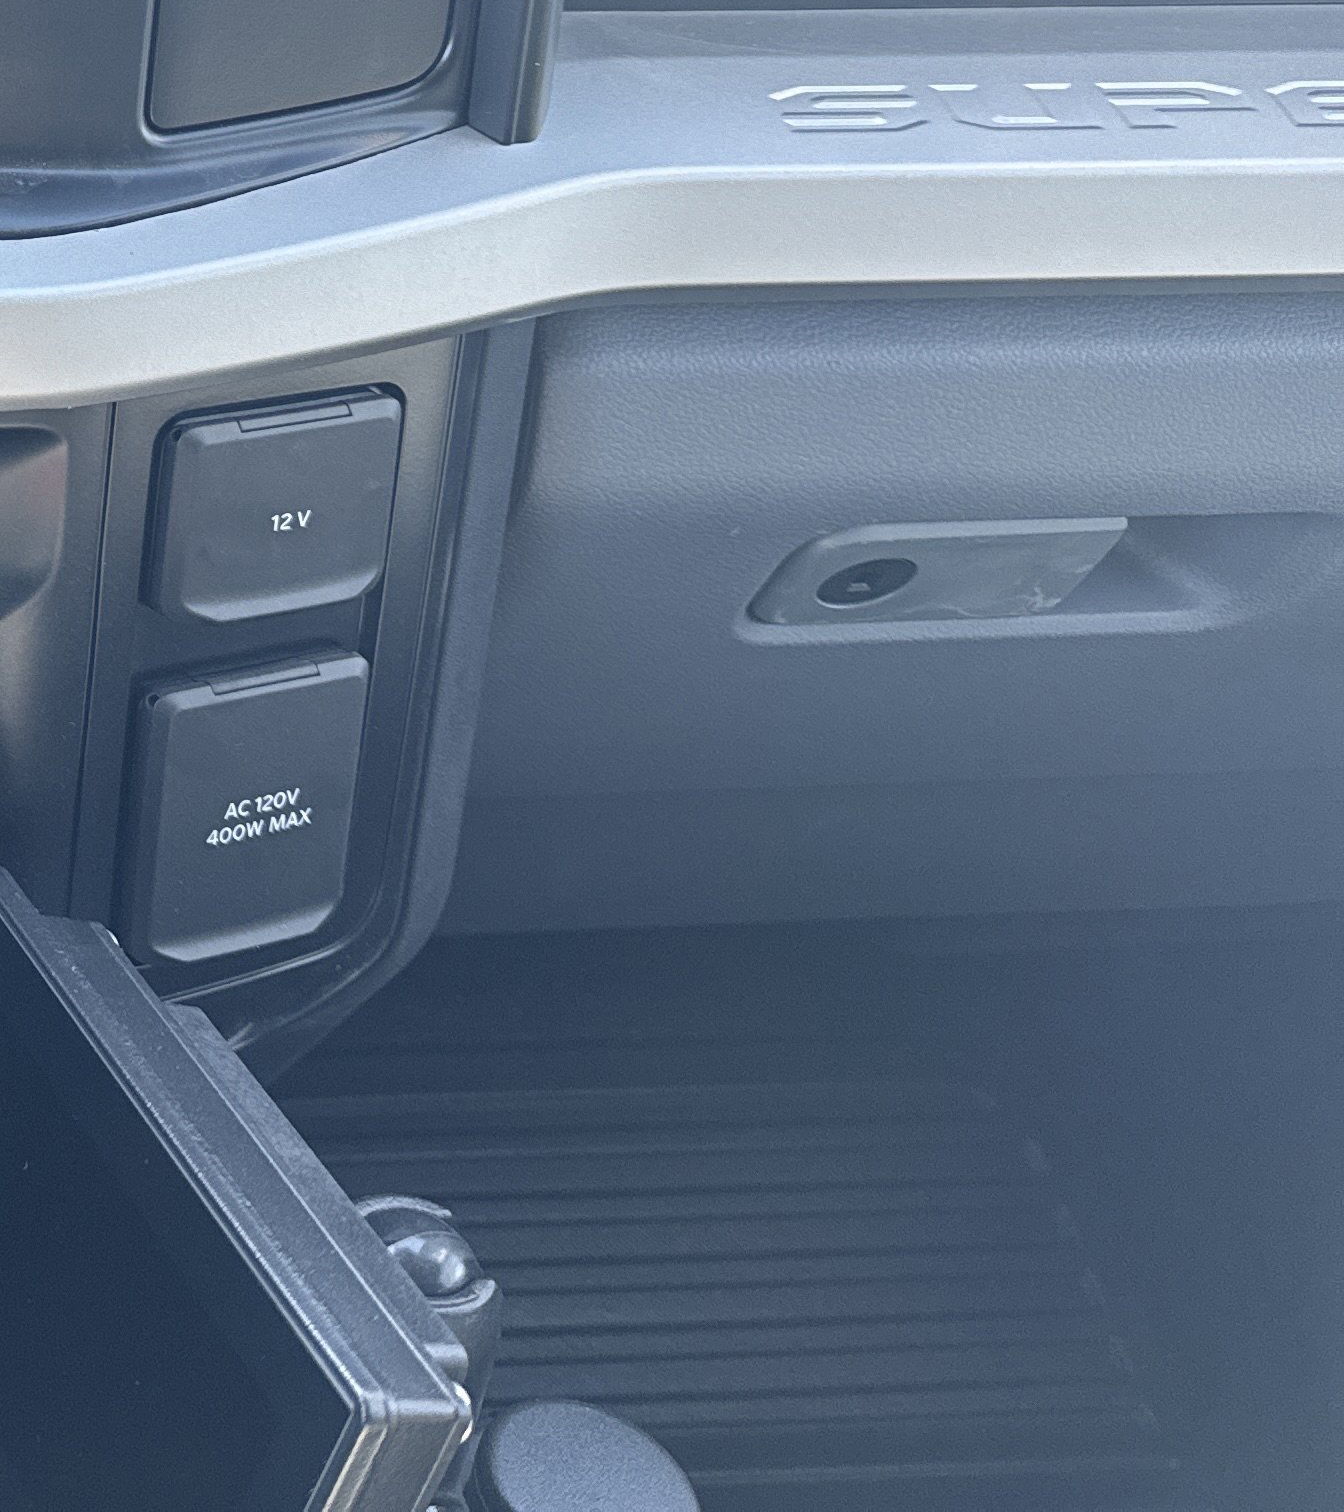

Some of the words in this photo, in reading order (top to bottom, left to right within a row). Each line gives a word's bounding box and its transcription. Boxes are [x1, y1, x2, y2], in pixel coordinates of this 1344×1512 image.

[271, 512, 293, 532] 12
[297, 509, 312, 527] V
[223, 799, 252, 821] AC
[254, 787, 301, 814] 120V
[205, 818, 265, 847] 400W
[268, 807, 313, 834] MAX
